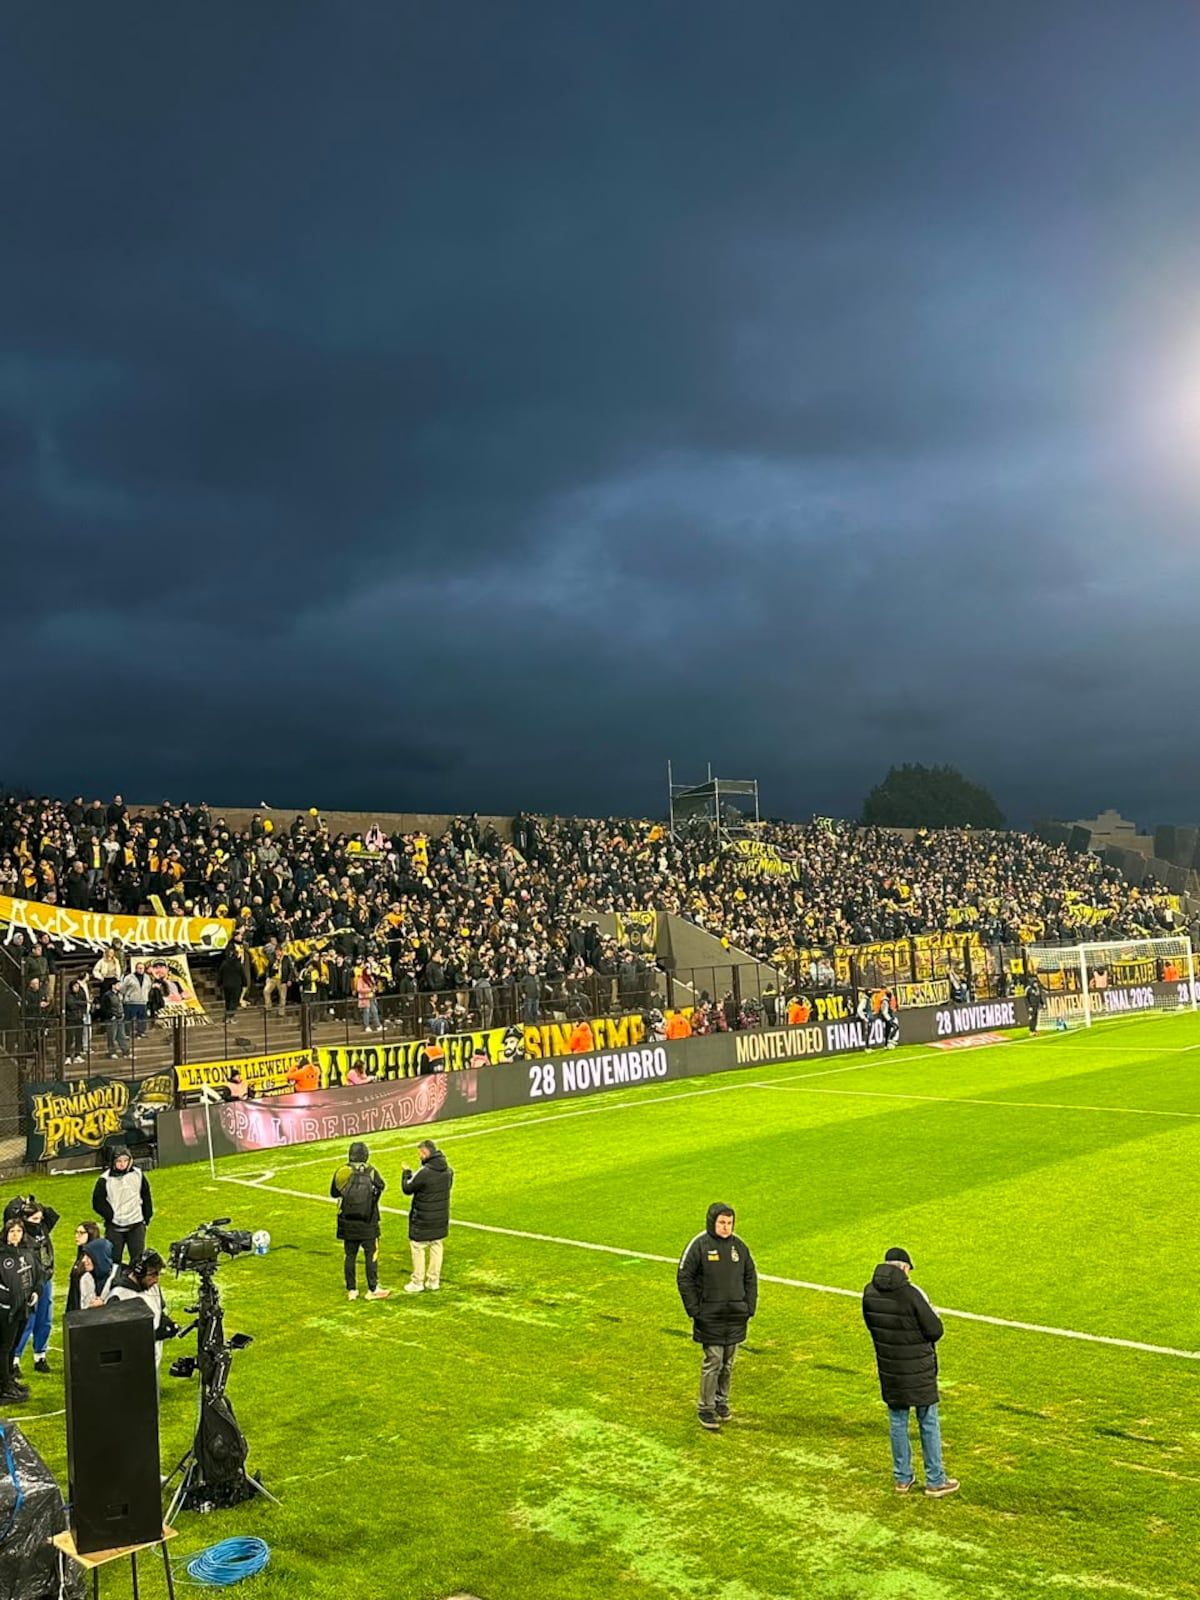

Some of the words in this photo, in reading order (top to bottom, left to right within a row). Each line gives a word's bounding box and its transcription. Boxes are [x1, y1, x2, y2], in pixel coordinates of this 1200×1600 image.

[935, 1010, 951, 1035] 28
[953, 1002, 1016, 1033] NOVIEMBRE
[1103, 988, 1131, 1011] FINAL
[1130, 986, 1154, 1008] 2026
[735, 1026, 823, 1064] MONTEVIDEO
[826, 1021, 866, 1052] FINAL
[868, 1018, 887, 1045] 20
[69, 1079, 87, 1096] LA
[529, 1064, 556, 1098] 28
[562, 1047, 668, 1093] NOVEMBRO
[32, 1080, 129, 1135] HERMANDAD
[39, 1108, 125, 1160] PIRATA
